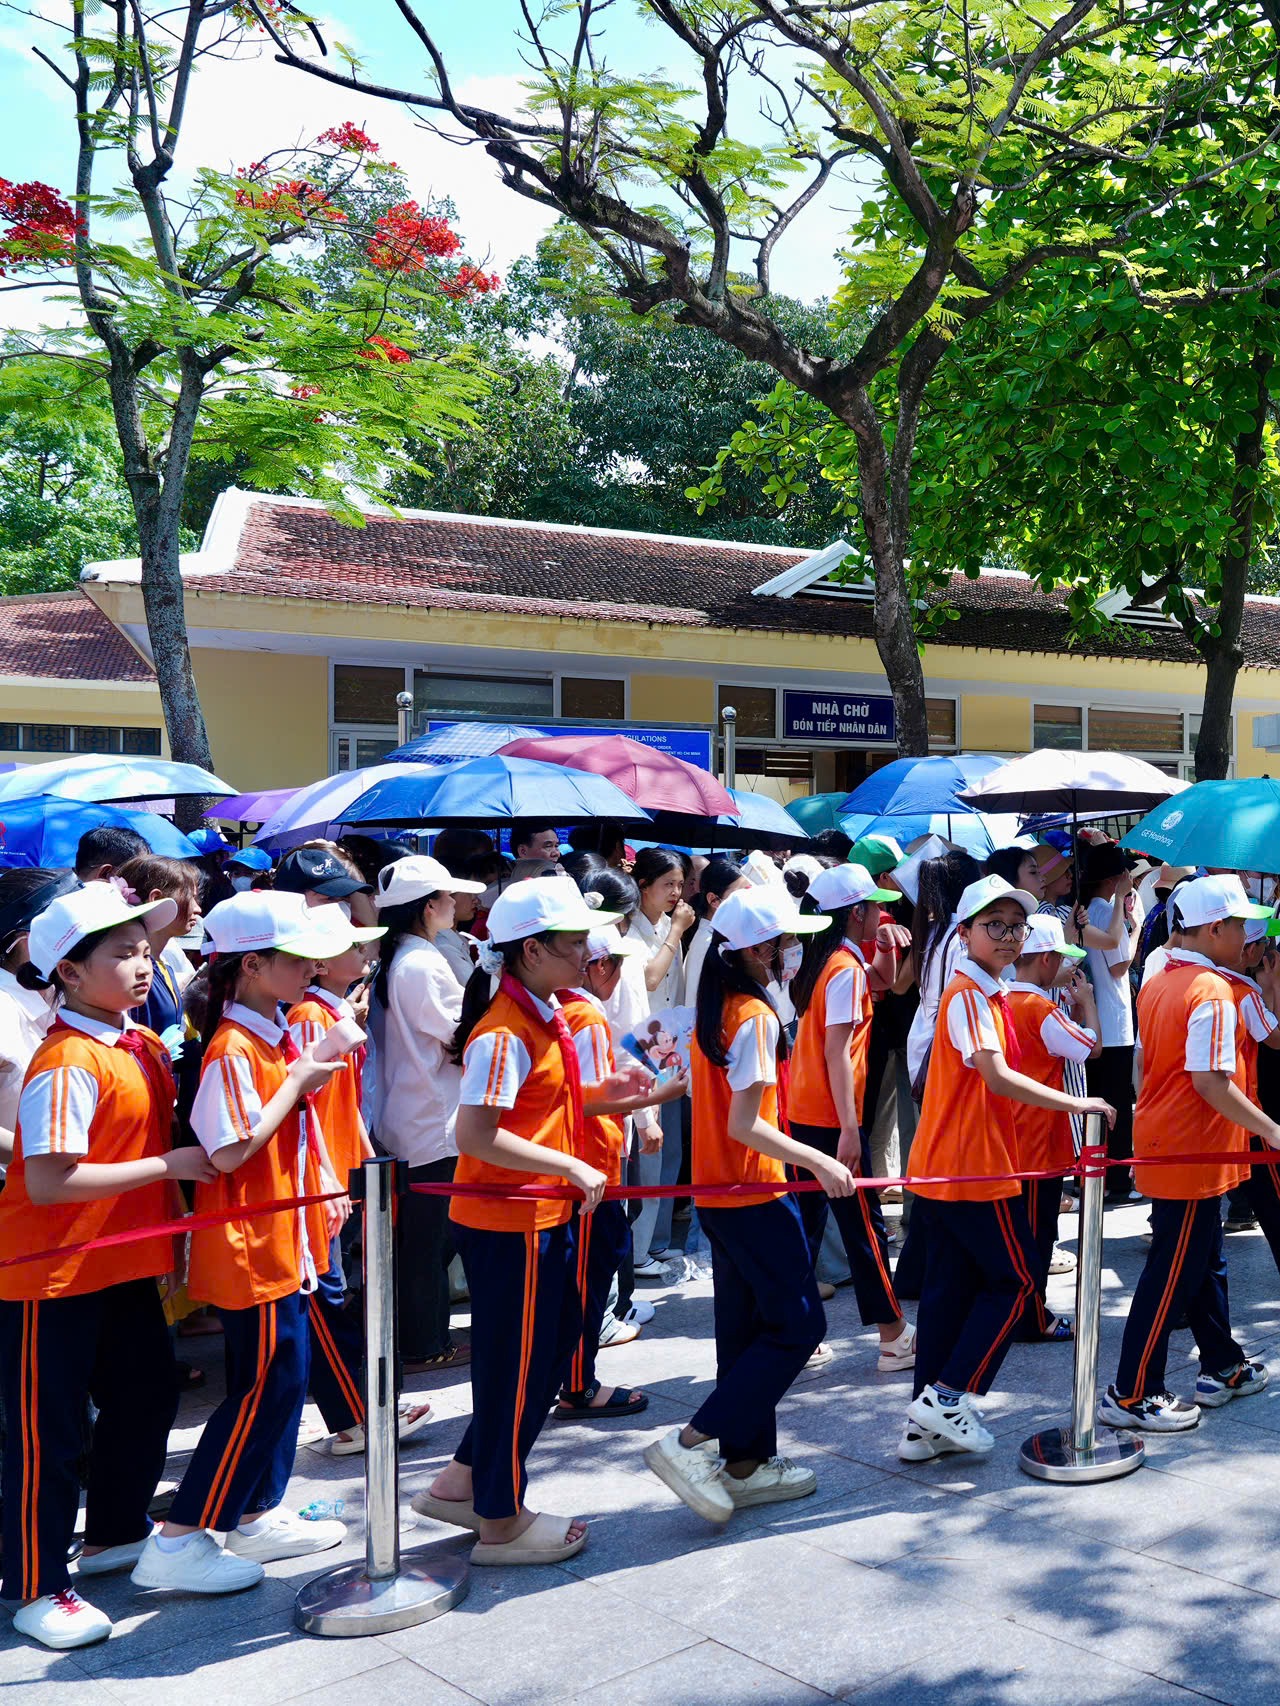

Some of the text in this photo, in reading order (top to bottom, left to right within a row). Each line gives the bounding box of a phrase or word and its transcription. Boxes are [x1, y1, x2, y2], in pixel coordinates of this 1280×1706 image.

[812, 701, 870, 717] NHÀ CHỜ
[793, 718, 887, 735] ĐÓN TIẾP NHÂN DÂN
[1141, 829, 1174, 847] GE Haiphong
